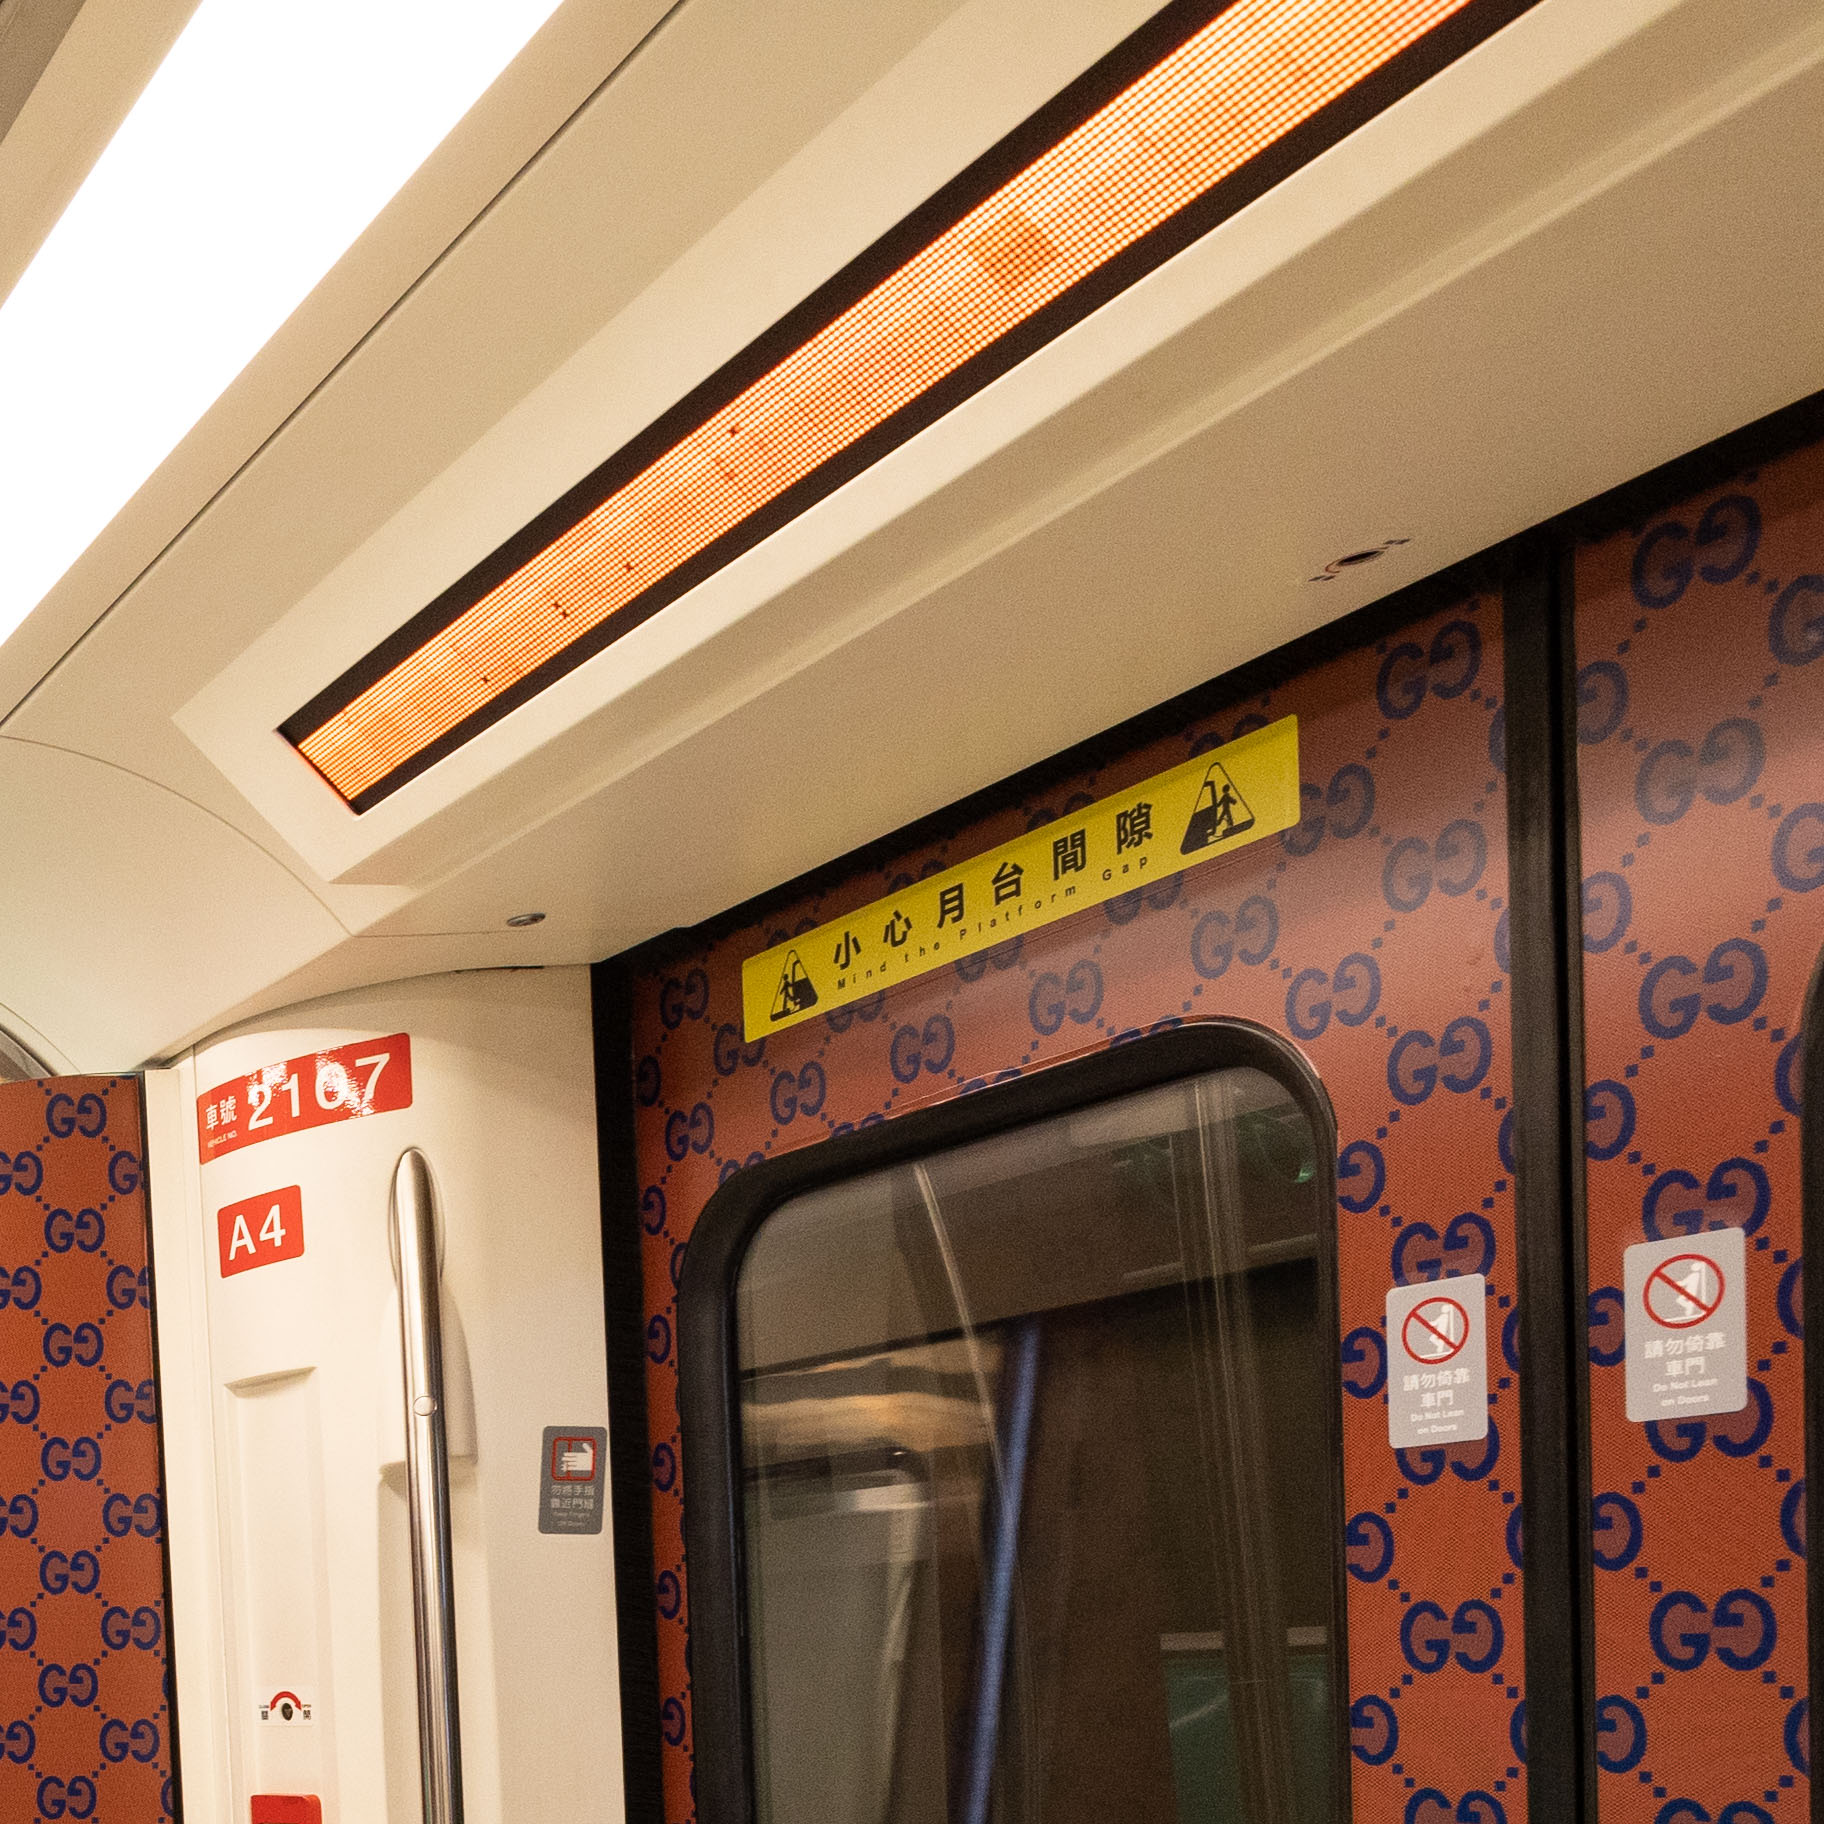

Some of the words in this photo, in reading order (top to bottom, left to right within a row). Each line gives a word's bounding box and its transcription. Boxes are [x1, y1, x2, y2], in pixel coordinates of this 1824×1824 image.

[833, 801, 1154, 971] 小心月台間隙
[837, 961, 888, 991] Mind
[904, 940, 940, 965] the
[959, 884, 1077, 941] Platform
[1102, 855, 1150, 882] Gap
[247, 1052, 391, 1131] 2107
[205, 1095, 237, 1131] 車號
[228, 1204, 286, 1261] A4
[1664, 1356, 1705, 1378] 車門
[1670, 1379, 1688, 1391] Not
[1420, 1389, 1453, 1408] 車門
[1425, 1410, 1439, 1421] Not
